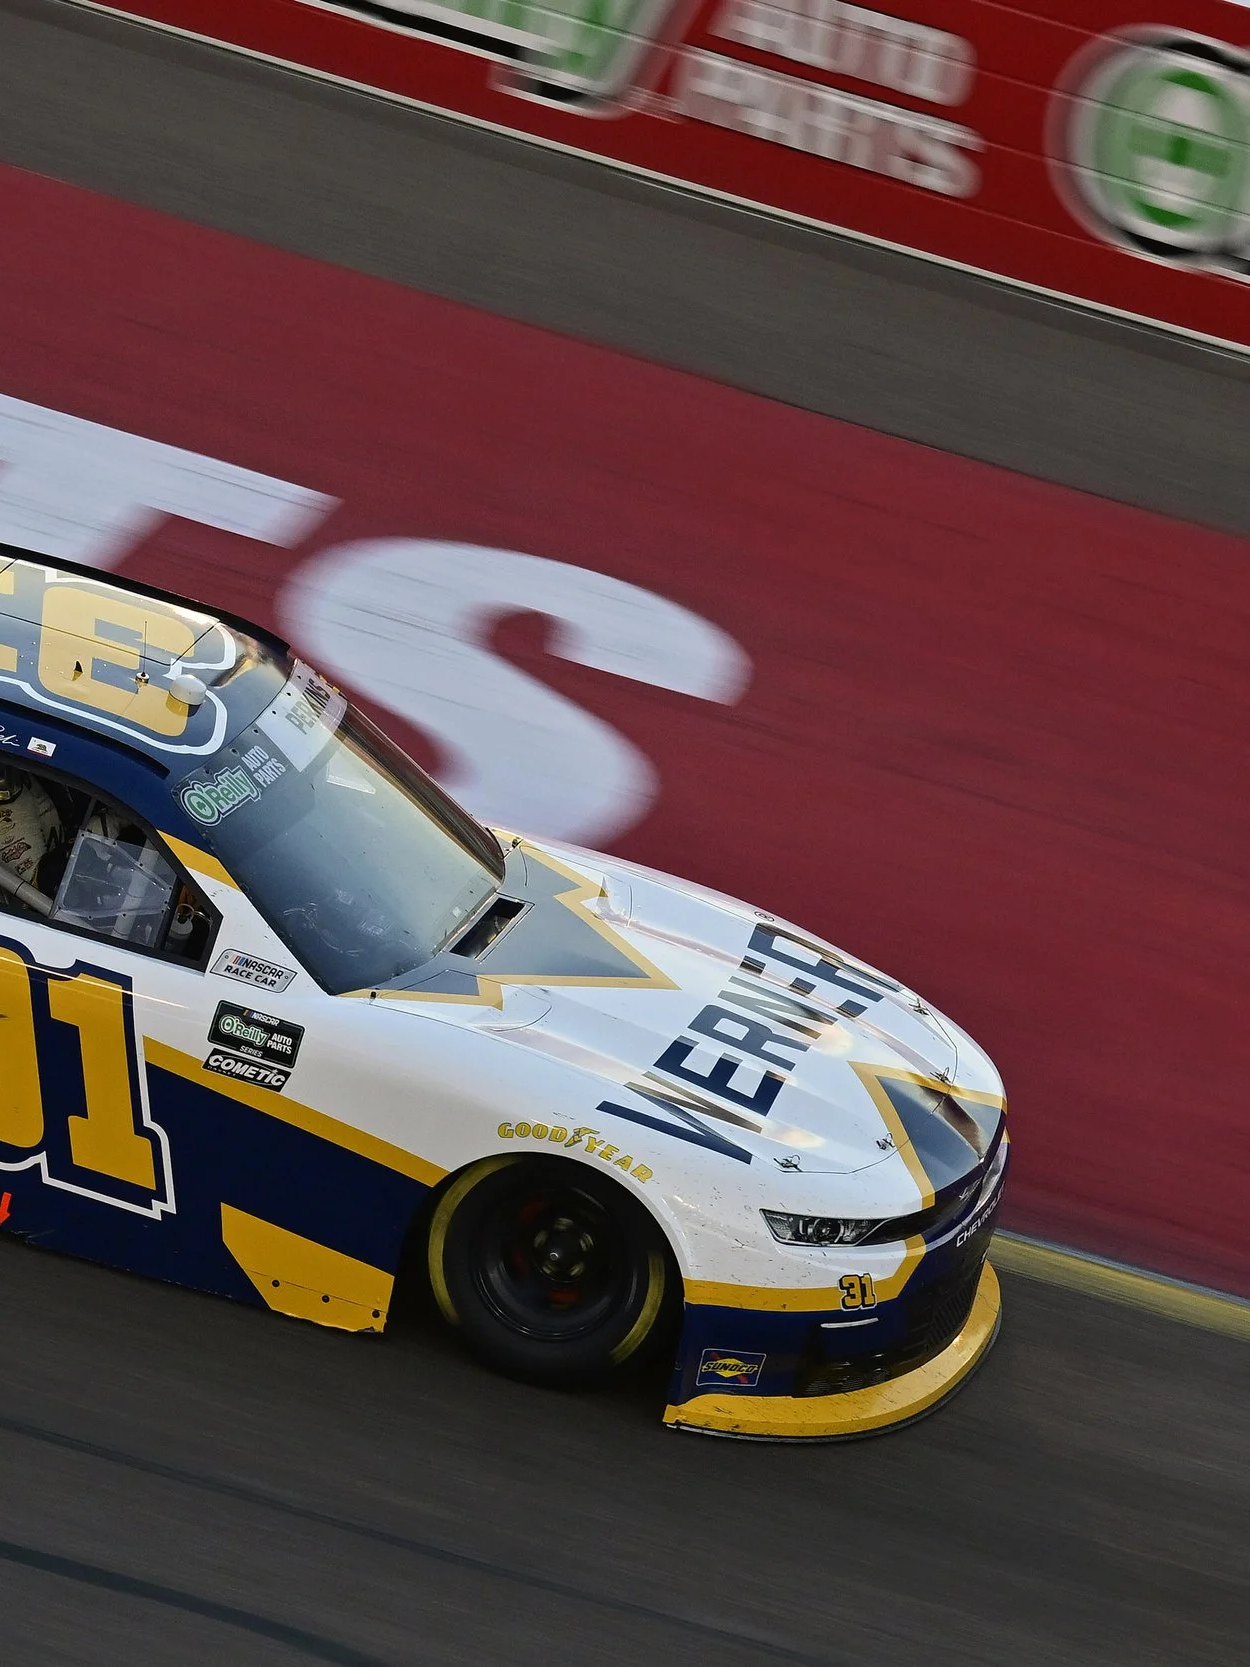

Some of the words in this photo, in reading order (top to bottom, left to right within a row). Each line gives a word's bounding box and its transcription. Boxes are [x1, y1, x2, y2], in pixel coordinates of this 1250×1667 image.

[668, 42, 986, 200] PARTS
[241, 745, 270, 772] AUTO
[253, 758, 287, 788] PARTS
[224, 965, 253, 980] RACE
[254, 974, 277, 988] CAR
[241, 957, 284, 980] NASCAR
[221, 1015, 268, 1046] O'Reilly
[251, 1011, 280, 1027] NASCAR
[239, 1045, 264, 1058] SERIES
[266, 1040, 293, 1055] PARTS
[271, 1033, 293, 1046] AUTO
[595, 923, 902, 1165] WERNER
[208, 1054, 286, 1087] COMETIC
[838, 1273, 878, 1311] 31
[701, 1357, 759, 1373] SUNOCO
